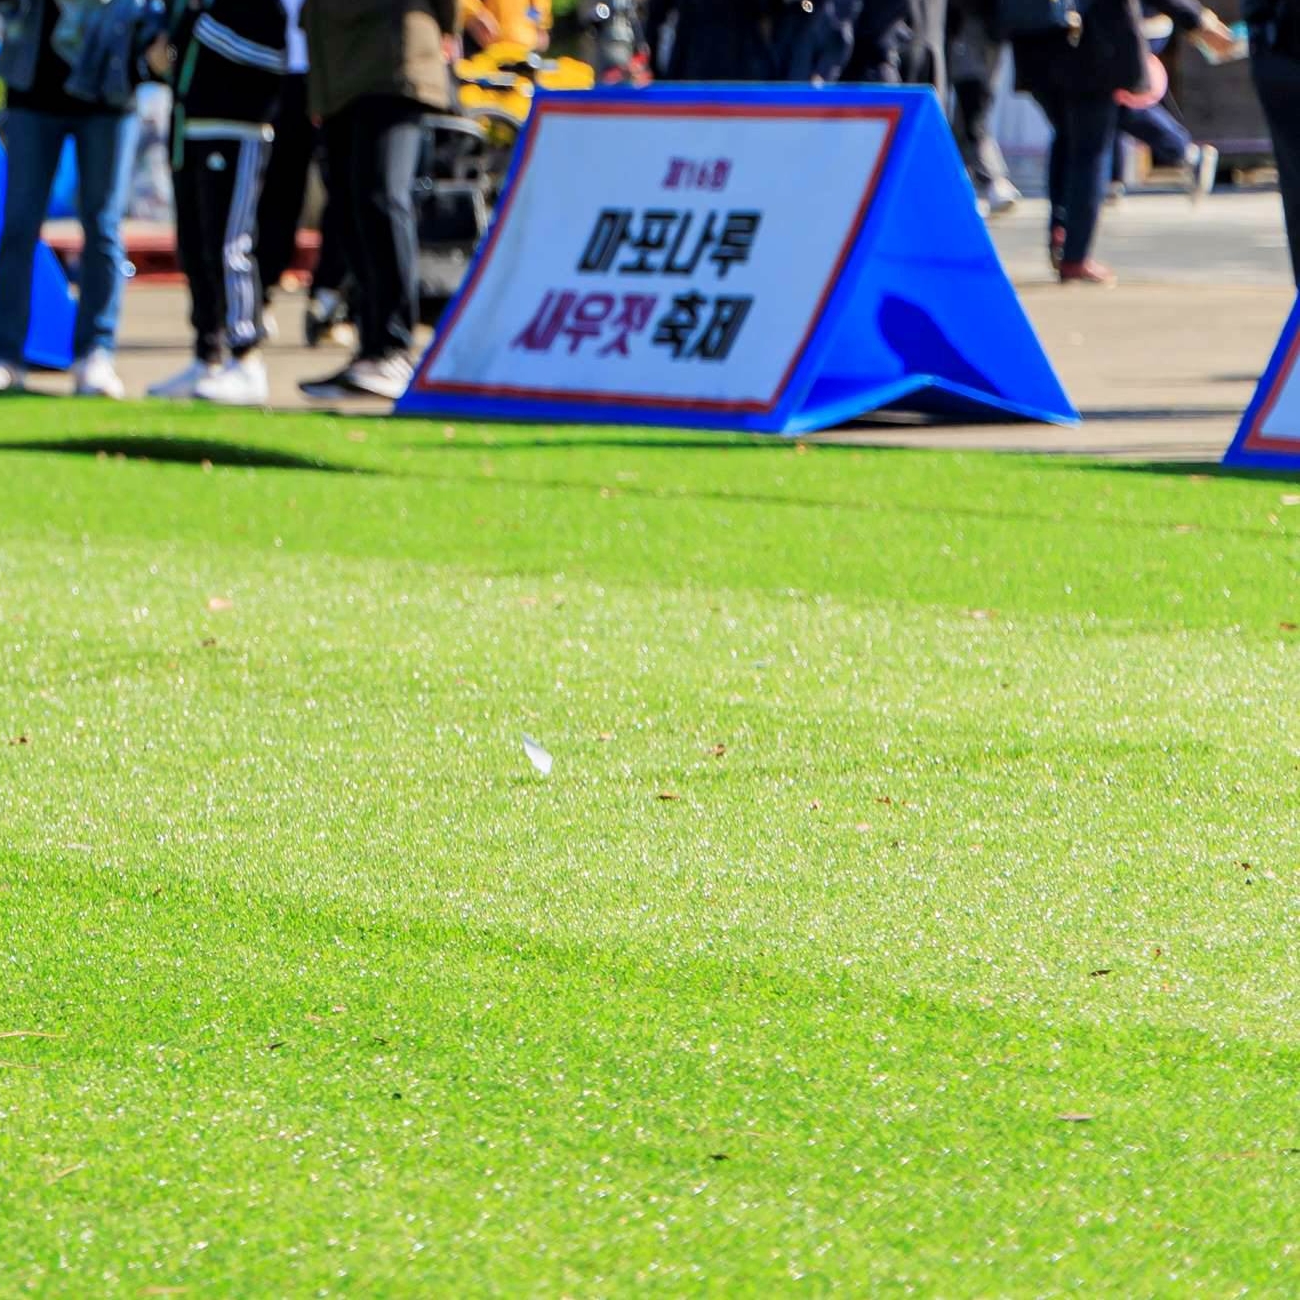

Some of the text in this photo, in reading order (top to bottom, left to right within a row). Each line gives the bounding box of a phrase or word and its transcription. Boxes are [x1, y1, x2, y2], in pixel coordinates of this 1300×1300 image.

[579, 210, 761, 277] 마포나루
[511, 290, 754, 360] 새우젓 축제
